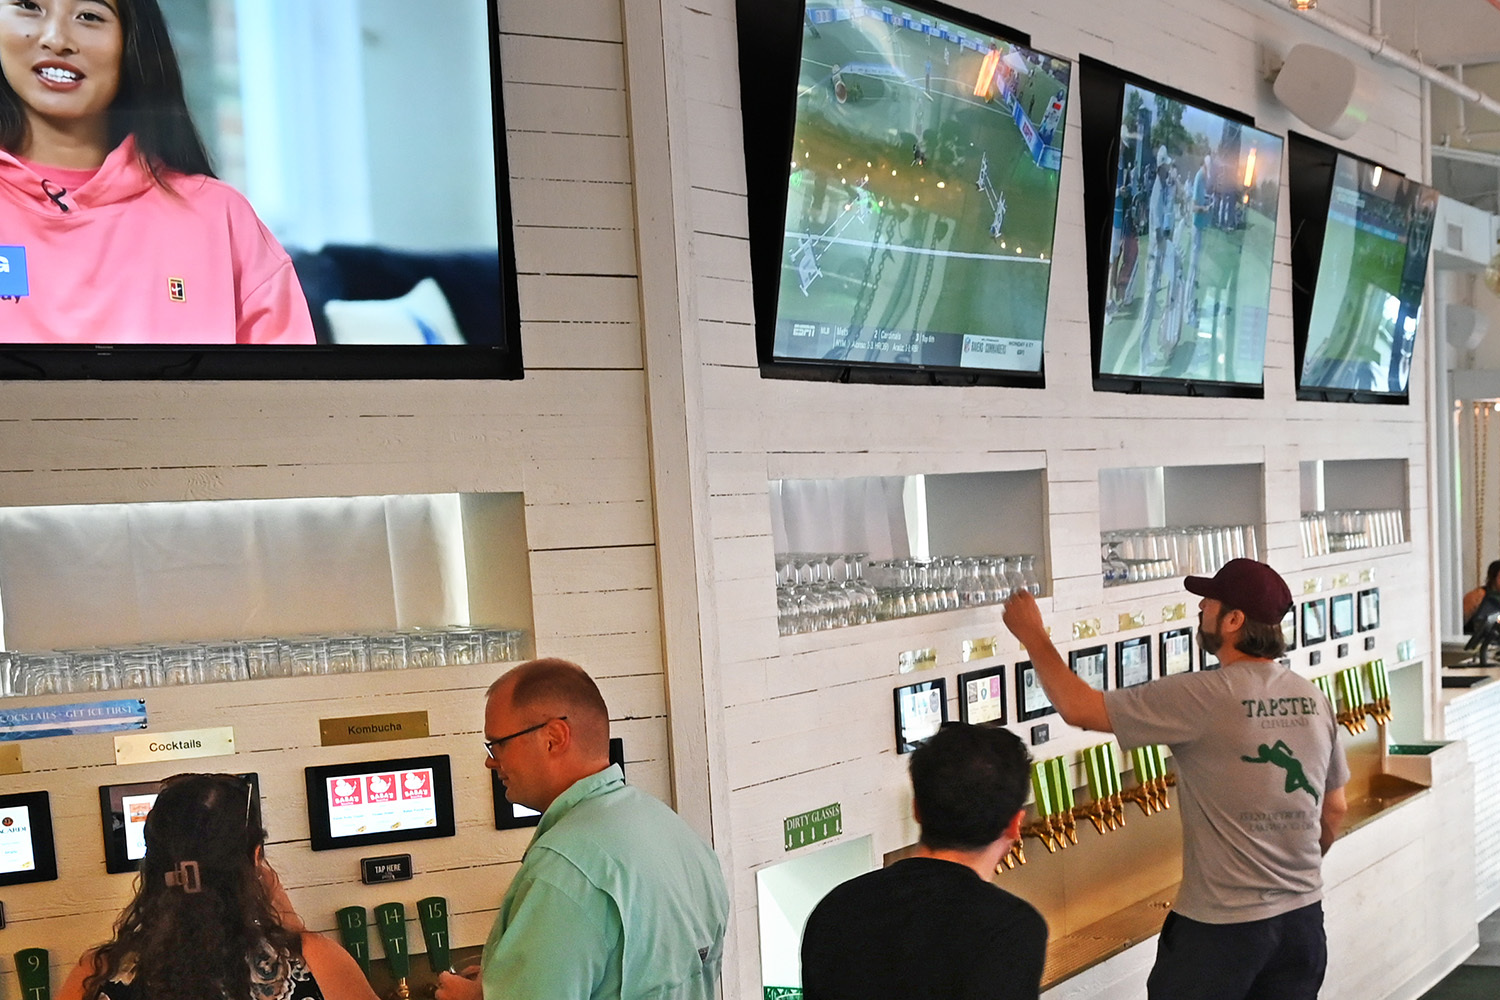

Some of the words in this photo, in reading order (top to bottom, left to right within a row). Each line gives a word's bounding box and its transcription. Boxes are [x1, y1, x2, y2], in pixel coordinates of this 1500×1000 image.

[793, 324, 816, 337] ESPN
[0, 710, 57, 724] COCKTAILS
[66, 709, 84, 718] GET
[88, 708, 102, 717] ICE
[106, 706, 132, 716] FIRST
[1241, 697, 1319, 718] TAPSTER
[348, 722, 402, 735] Kombucha
[149, 739, 202, 753] Cocktails
[786, 814, 810, 831] DIRTY
[811, 805, 840, 823] GLASSES
[374, 865, 386, 874] TAP
[386, 863, 401, 873] HERE
[384, 908, 401, 925] 14
[428, 903, 442, 919] 15
[347, 912, 362, 929] 13
[389, 937, 403, 954] T
[432, 931, 445, 948] T
[351, 941, 364, 958] T
[28, 955, 40, 972] 9
